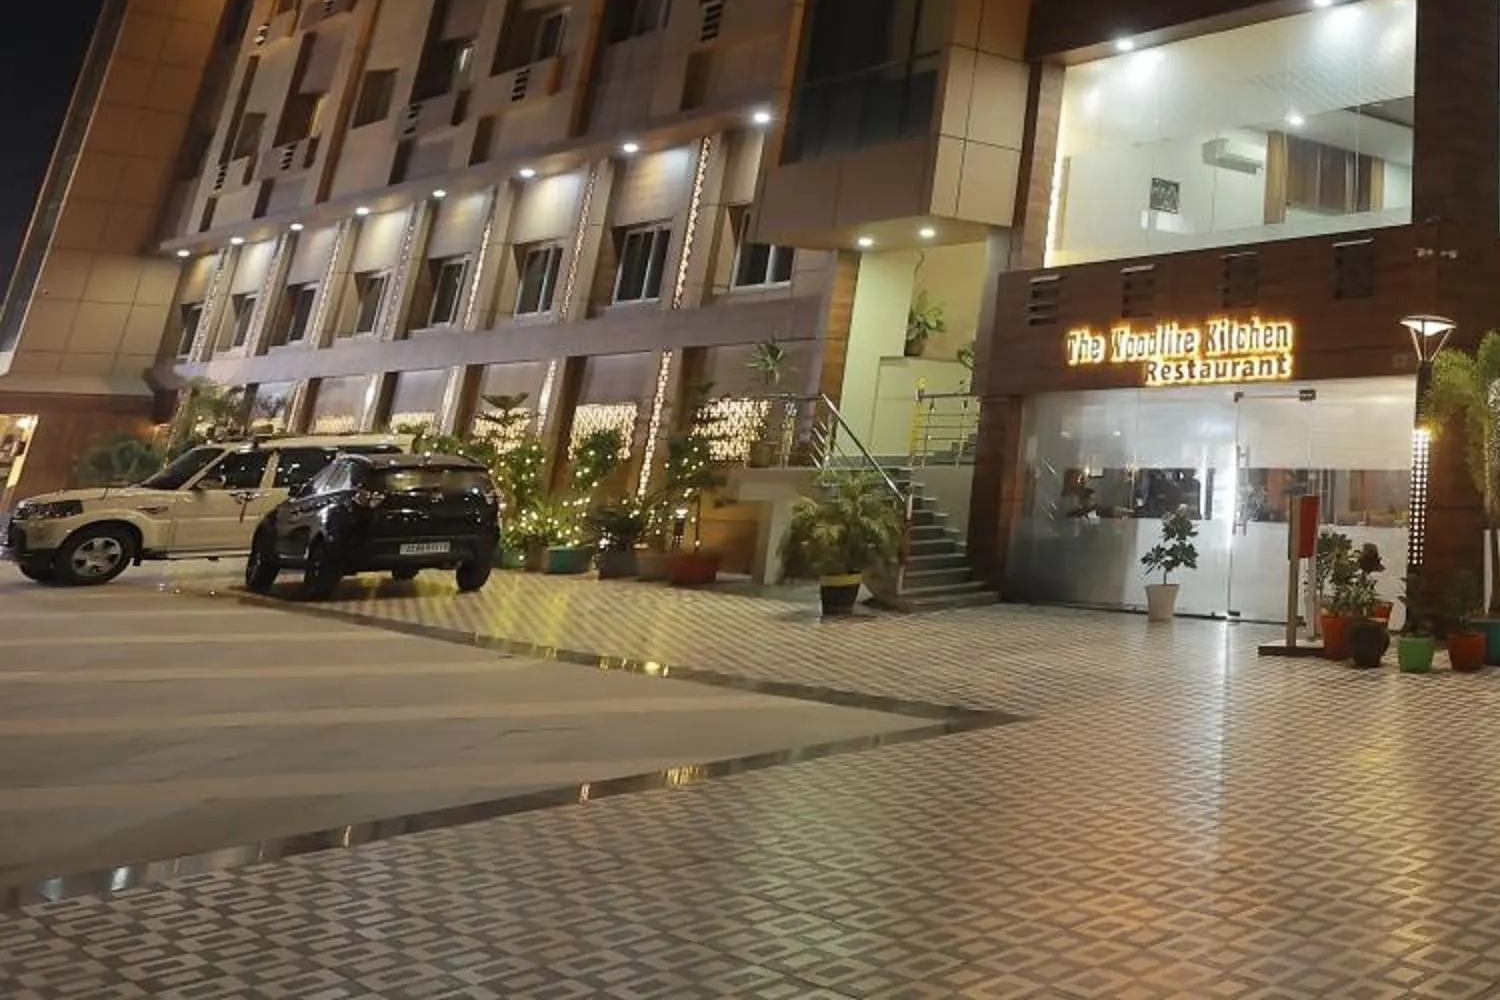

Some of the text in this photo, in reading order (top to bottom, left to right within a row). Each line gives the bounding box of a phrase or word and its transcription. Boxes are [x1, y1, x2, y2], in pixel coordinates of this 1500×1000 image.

[1067, 329, 1104, 364] The
[1204, 316, 1292, 356] Kitchen
[1143, 353, 1292, 385] Restaurant
